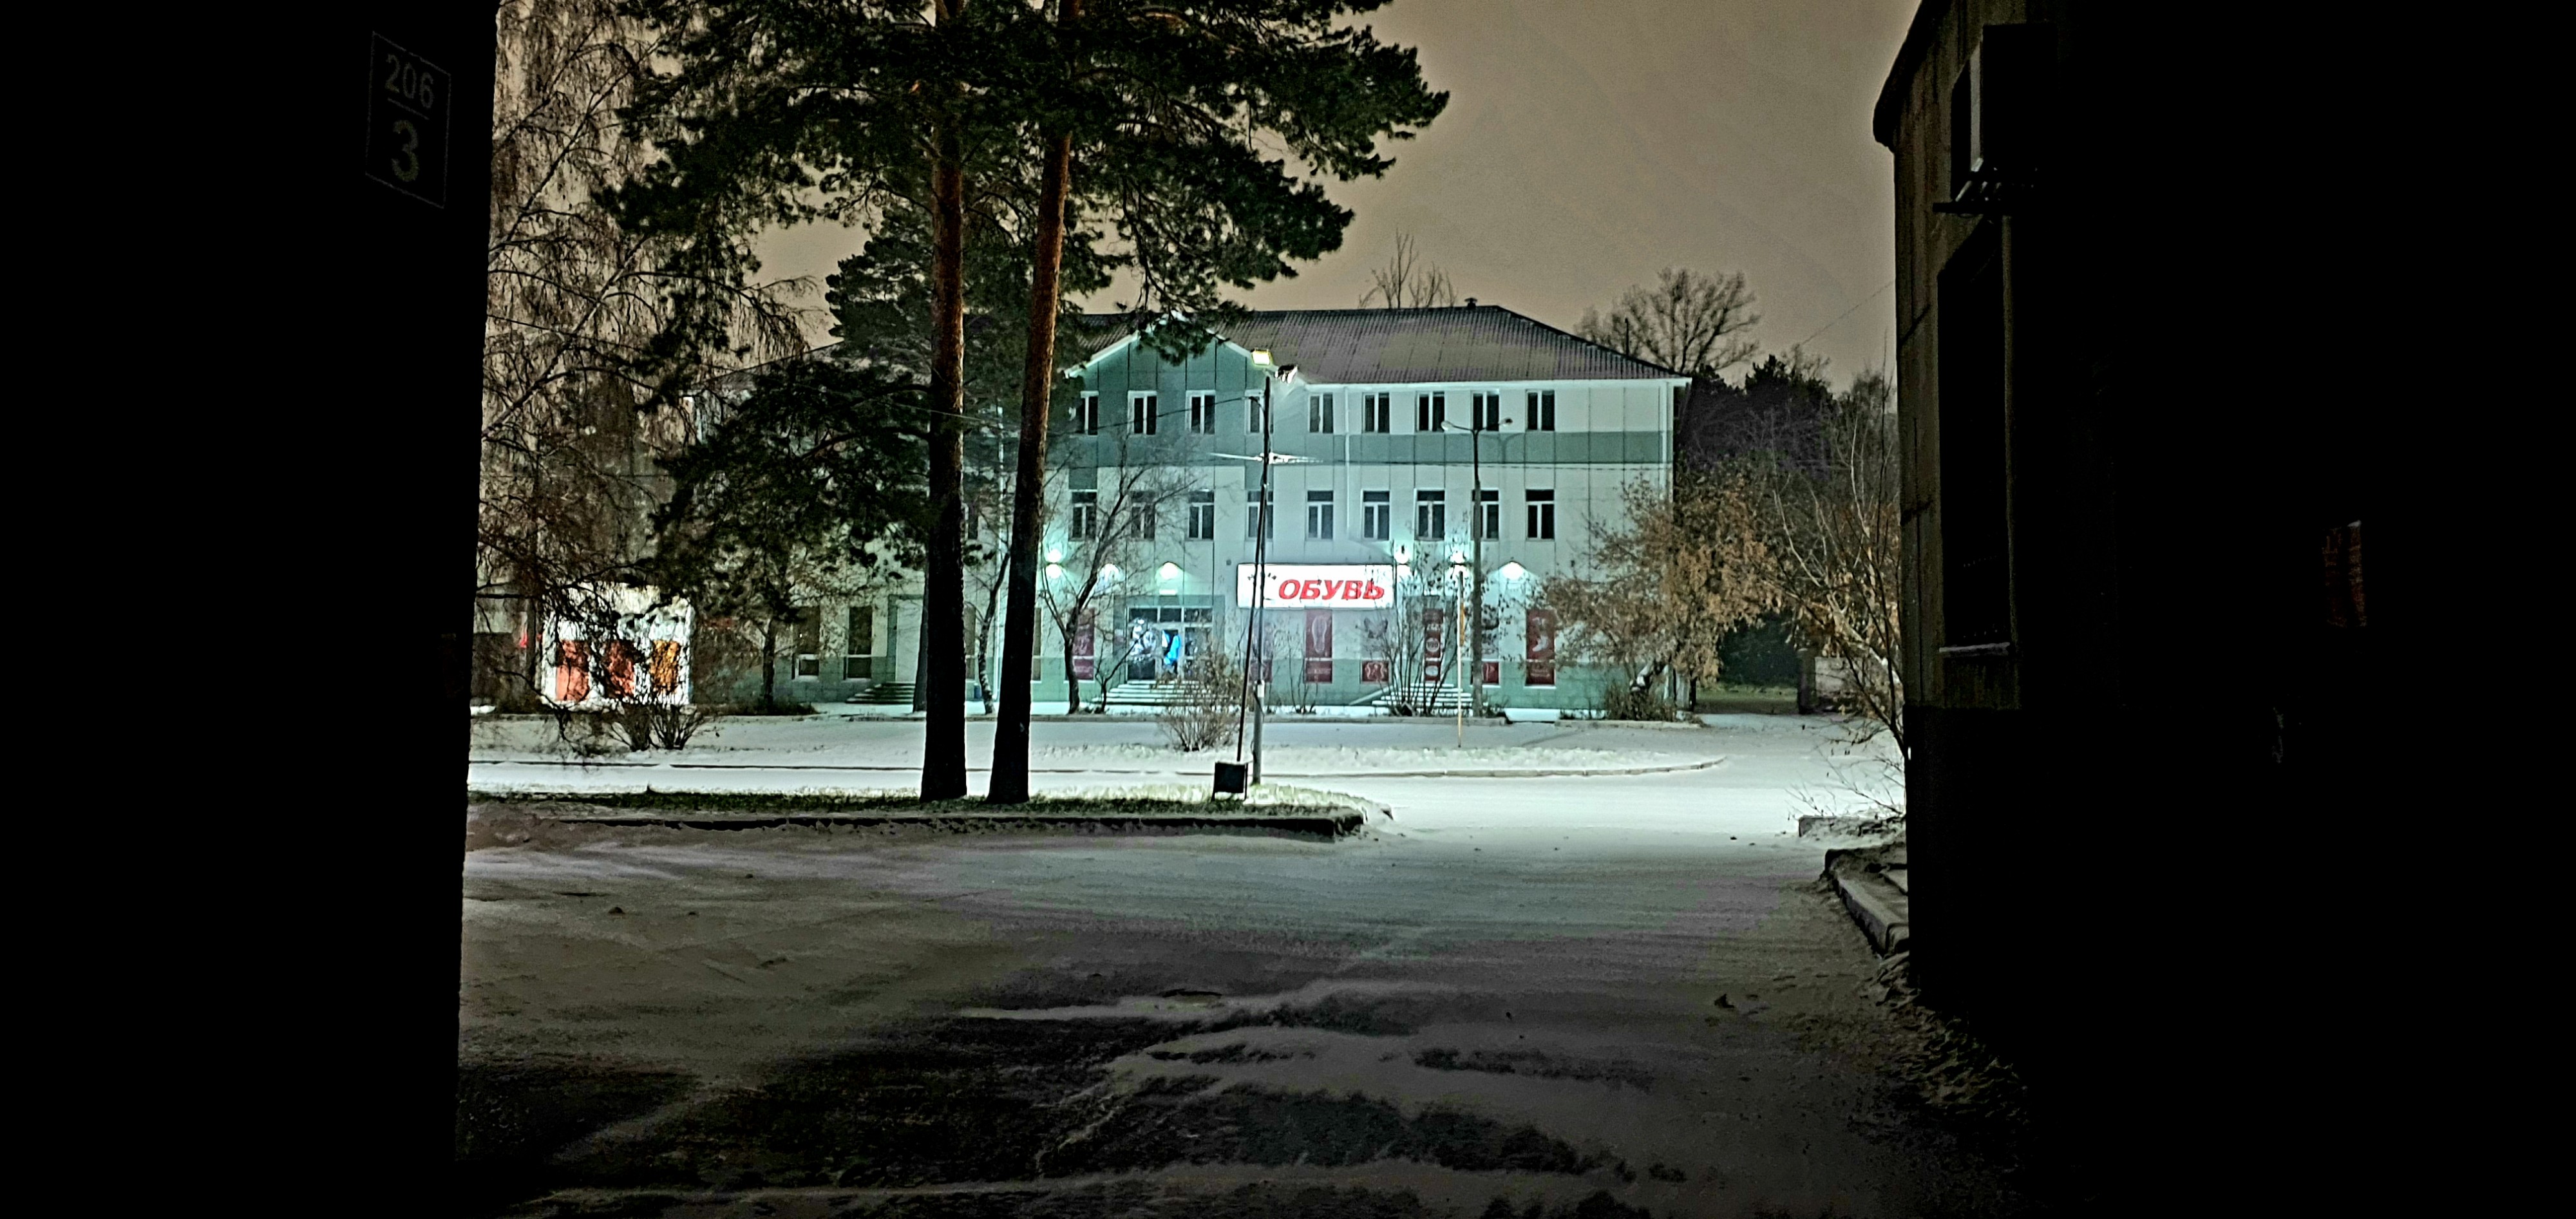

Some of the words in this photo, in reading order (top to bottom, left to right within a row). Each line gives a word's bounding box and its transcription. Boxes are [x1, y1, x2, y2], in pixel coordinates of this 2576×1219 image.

[384, 53, 435, 110] 206
[390, 118, 421, 183] 3
[1278, 579, 1385, 600] ОБУВЬ
